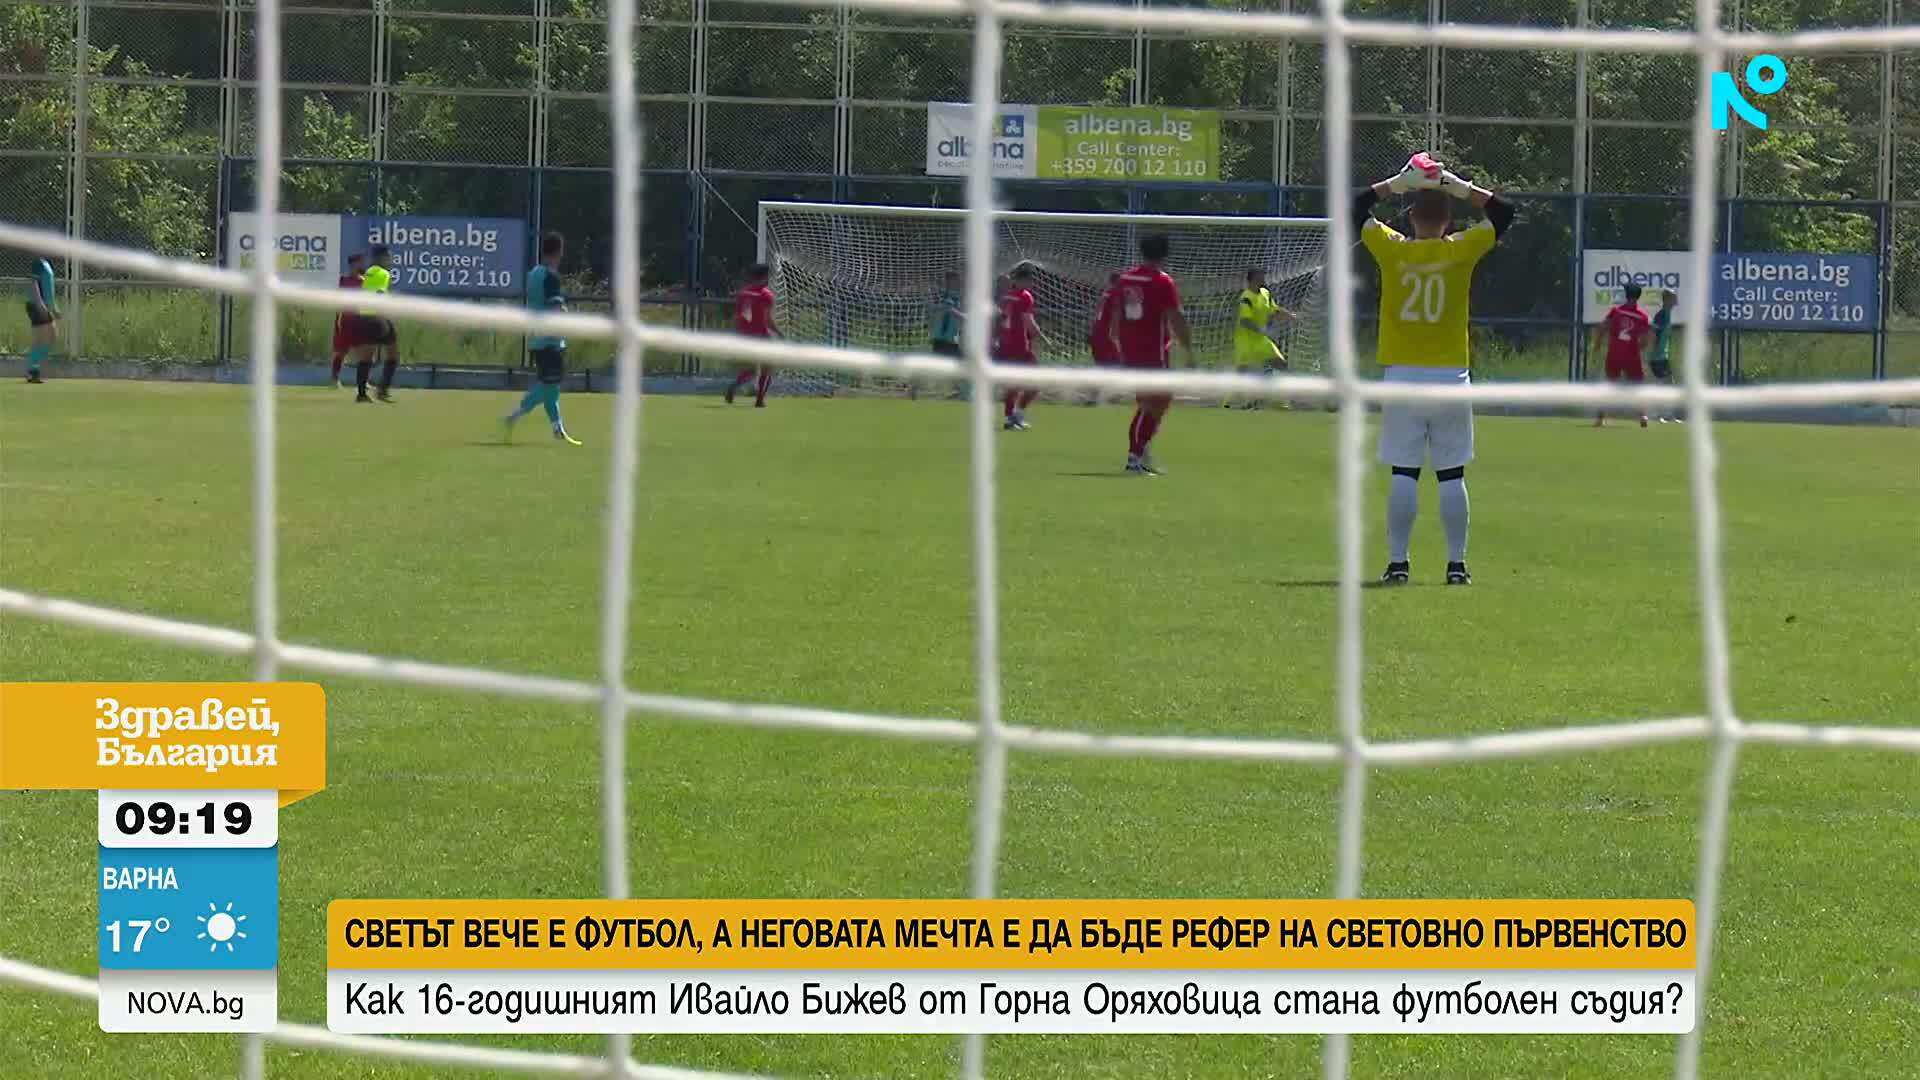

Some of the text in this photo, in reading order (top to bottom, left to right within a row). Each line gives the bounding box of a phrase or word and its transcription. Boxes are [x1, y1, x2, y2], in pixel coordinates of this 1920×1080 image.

[1065, 114, 1193, 140] albena.bg
[937, 136, 1024, 159] albna
[1078, 141, 1181, 156] Call Center:
[1052, 159, 1207, 176] +359 700 12 110
[240, 234, 328, 253] aena
[368, 221, 499, 251] albena.bg
[392, 252, 485, 268] all Center:
[408, 268, 442, 285] 700
[448, 269, 470, 286] 12
[478, 270, 511, 287] 110
[1594, 266, 1680, 289] albena
[1721, 259, 1850, 287] albena.bg
[1400, 272, 1445, 322] 20
[1734, 287, 1838, 302] Call Center:
[1760, 304, 1794, 321] 700
[1800, 304, 1823, 321] 12
[1830, 305, 1864, 322] 110
[1617, 319, 1634, 341] 2
